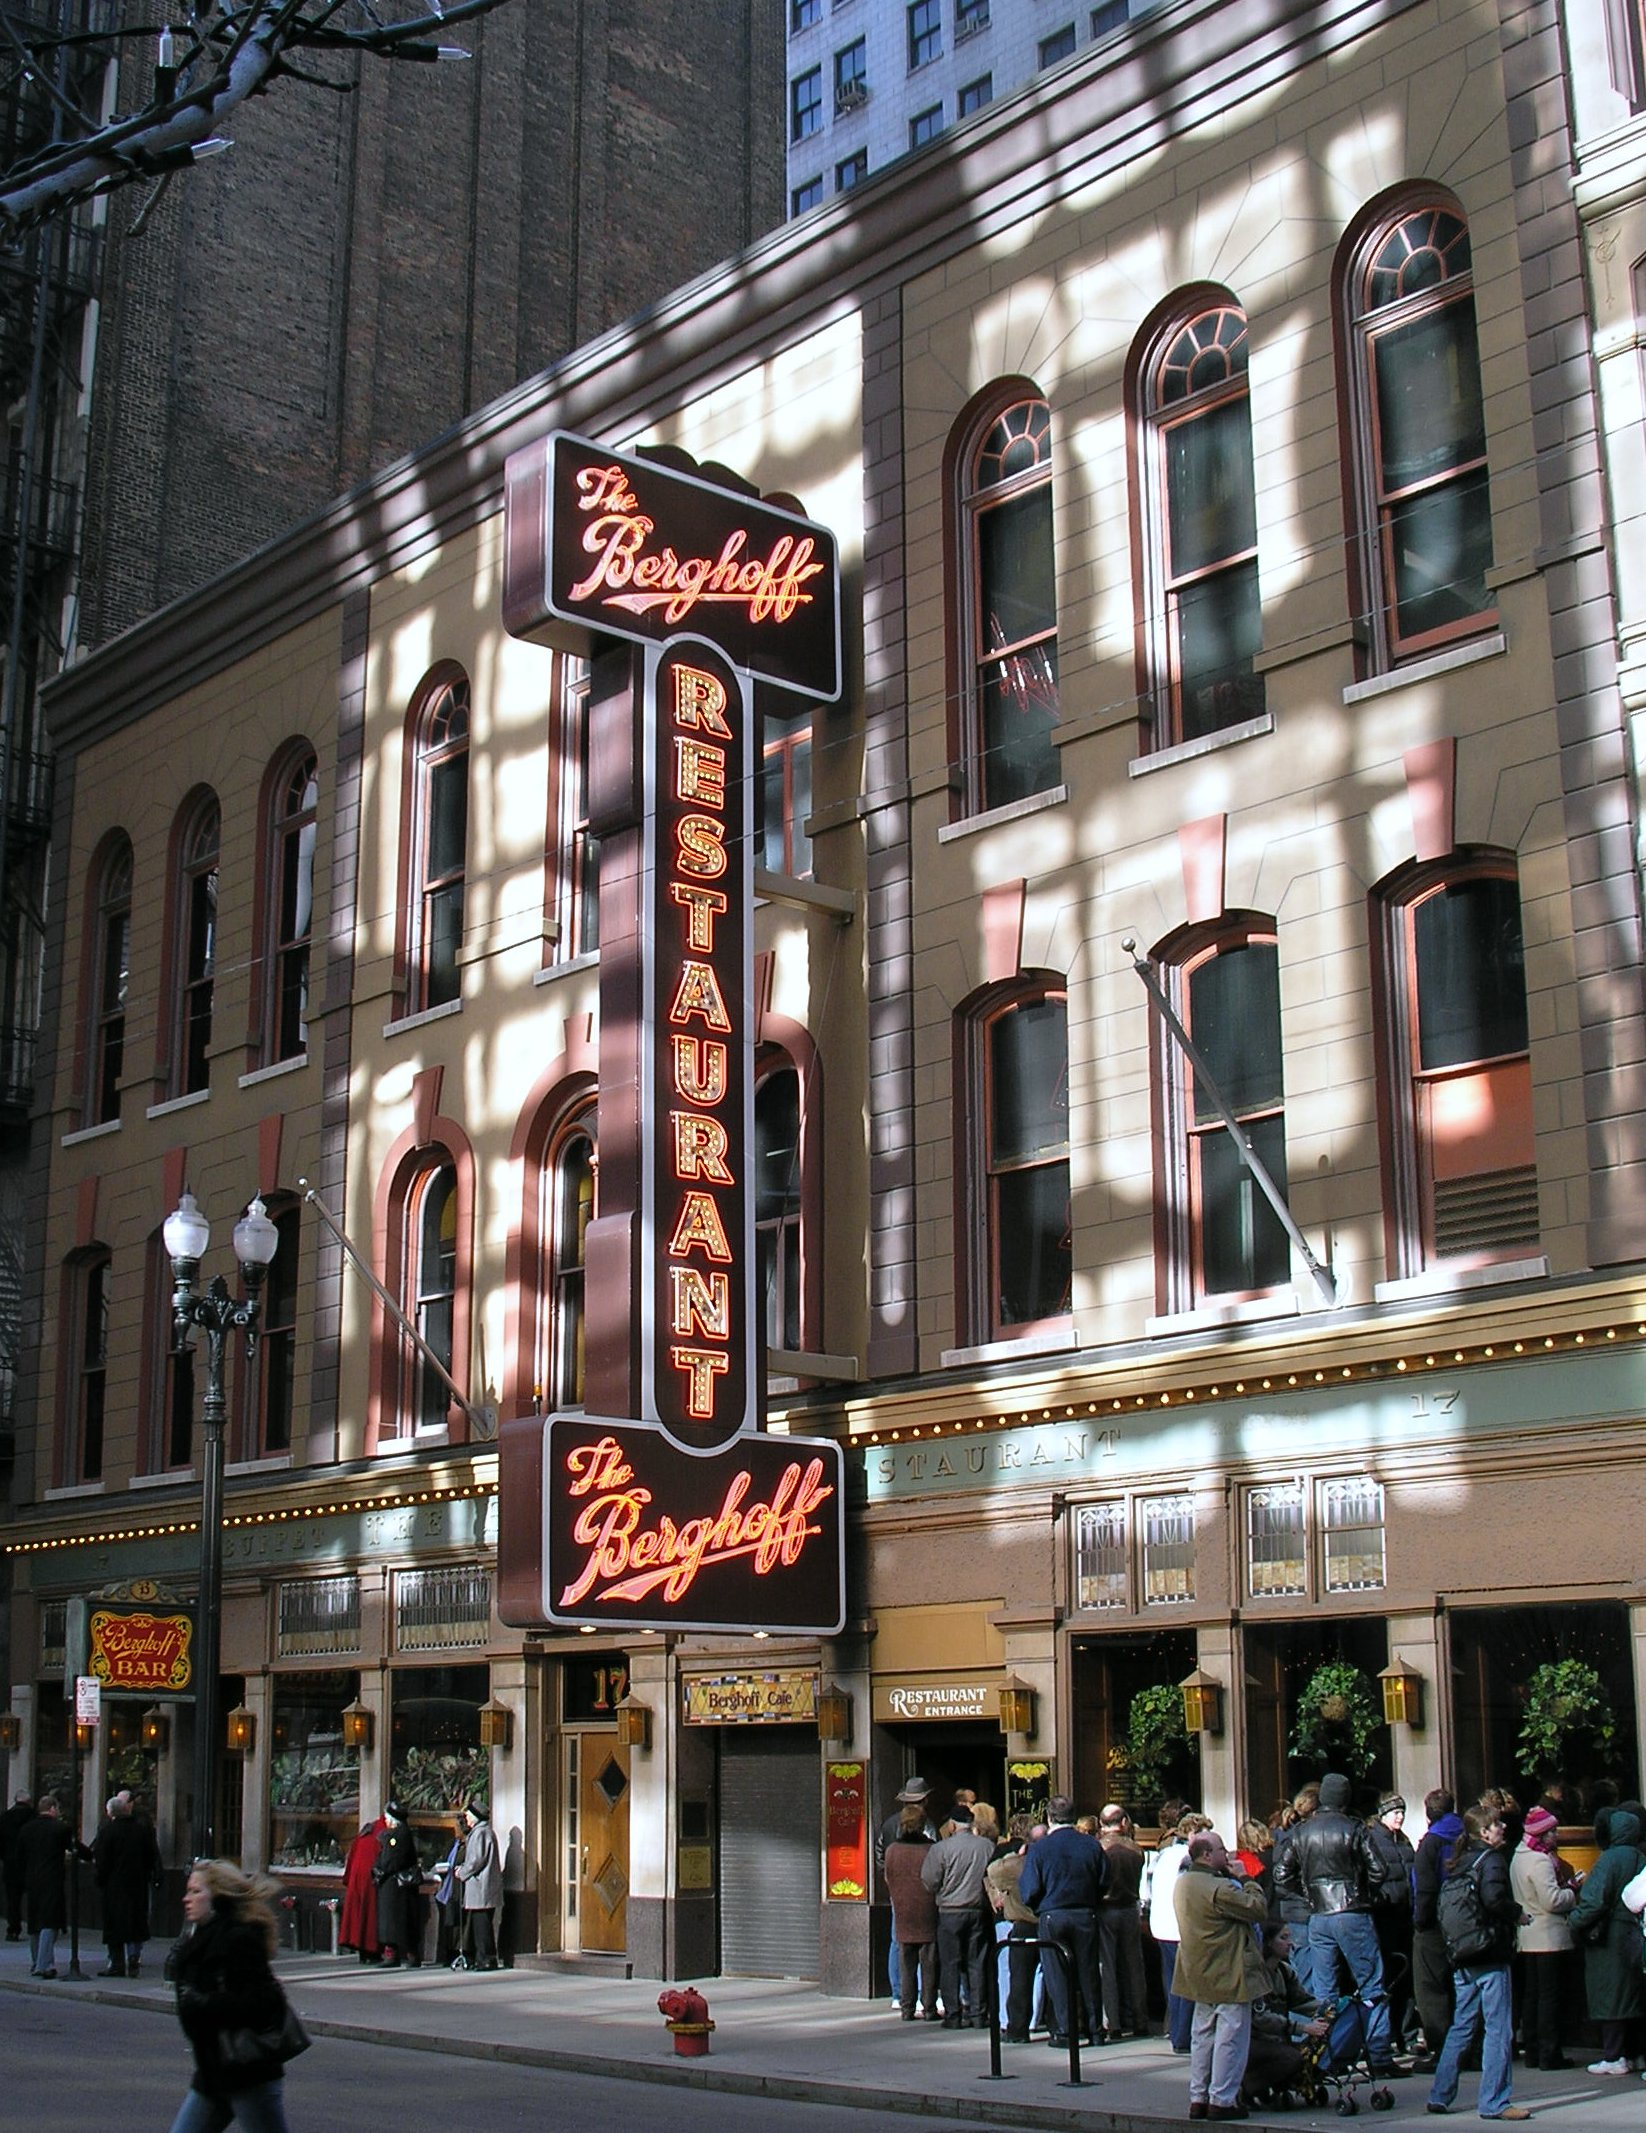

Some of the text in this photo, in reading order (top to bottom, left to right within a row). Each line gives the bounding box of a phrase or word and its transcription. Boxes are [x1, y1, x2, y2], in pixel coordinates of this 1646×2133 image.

[575, 465, 639, 512] The
[568, 514, 825, 625] Berghoff
[670, 663, 735, 1419] RESTAURANT
[1410, 1389, 1461, 1418] 17
[566, 1436, 635, 1496] The
[878, 1428, 1122, 1484] STAURANT
[365, 1510, 444, 1546] THE
[558, 1457, 835, 1607] Berghoff
[104, 1624, 177, 1659] Berghoff
[117, 1660, 167, 1677] BAR
[592, 1667, 627, 1709] 17
[708, 1690, 793, 1711] Berghoff Cafe
[889, 1688, 987, 1717] RESTAURANT
[924, 1705, 983, 1716] ENTRANCE
[1012, 1789, 1034, 1808] THE
